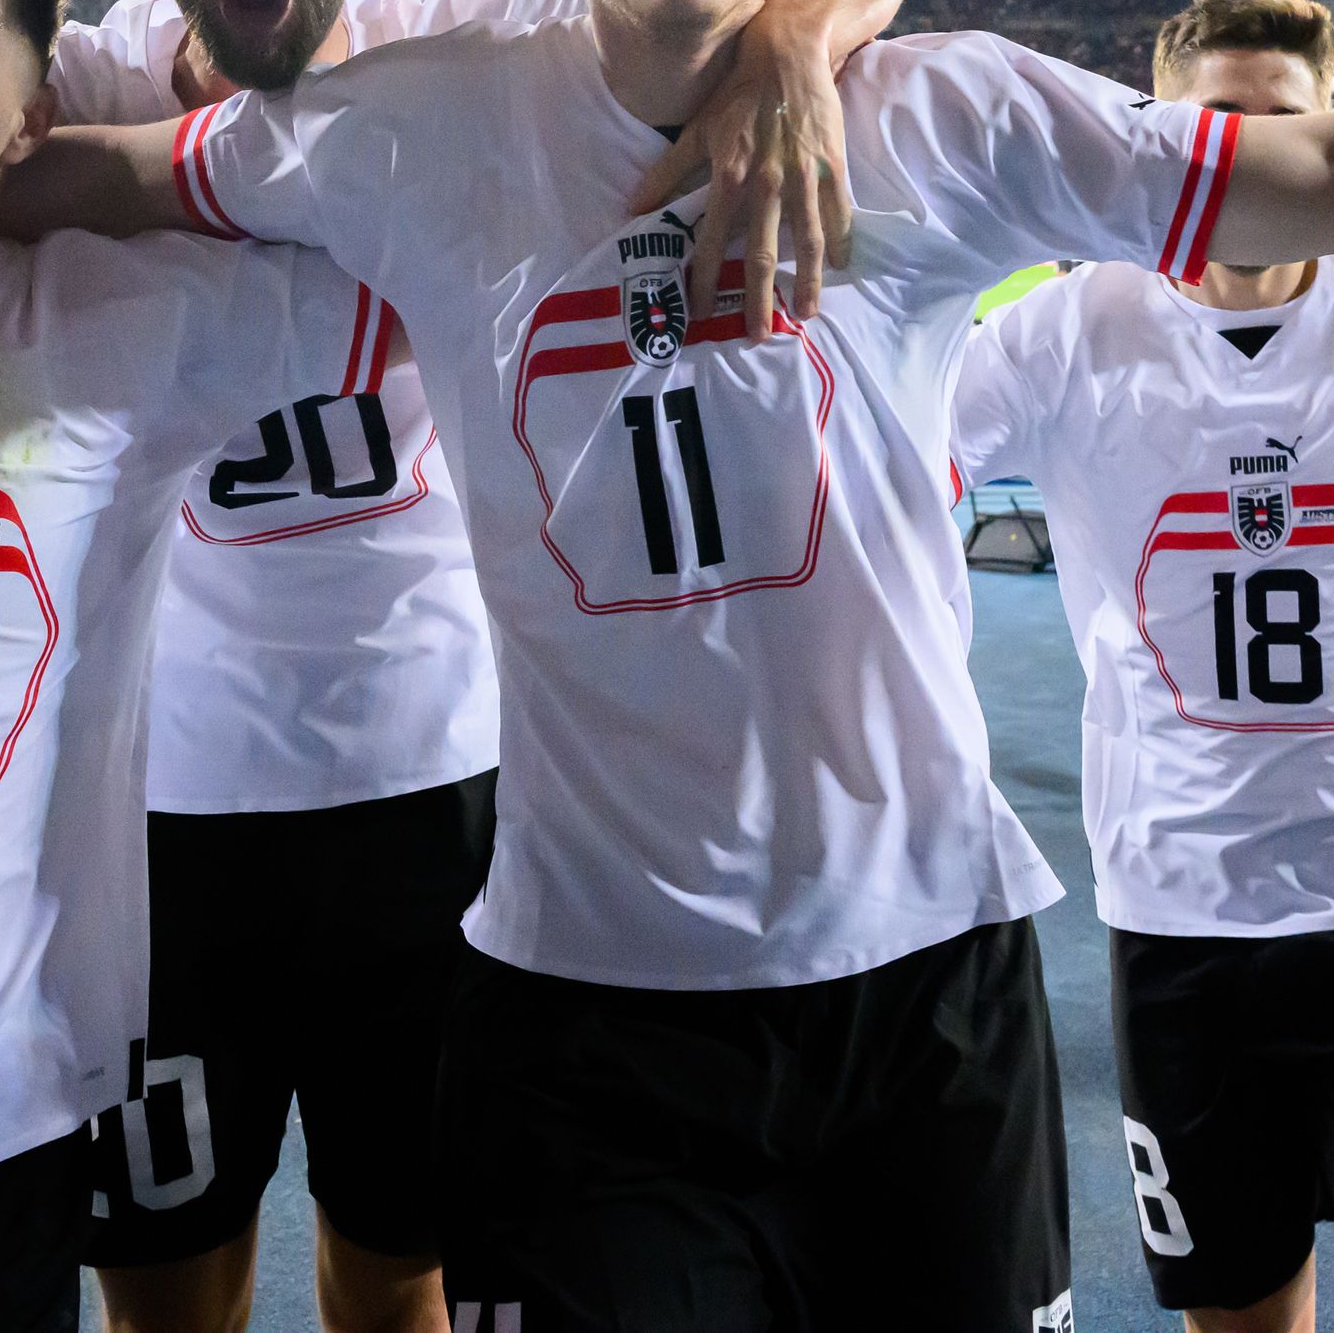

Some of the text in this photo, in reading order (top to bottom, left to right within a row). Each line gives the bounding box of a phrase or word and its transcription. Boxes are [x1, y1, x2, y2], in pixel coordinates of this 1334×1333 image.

[618, 232, 685, 264] PUMA
[621, 385, 725, 575] 11
[1229, 454, 1288, 475] PUMA
[1212, 568, 1323, 704] 18
